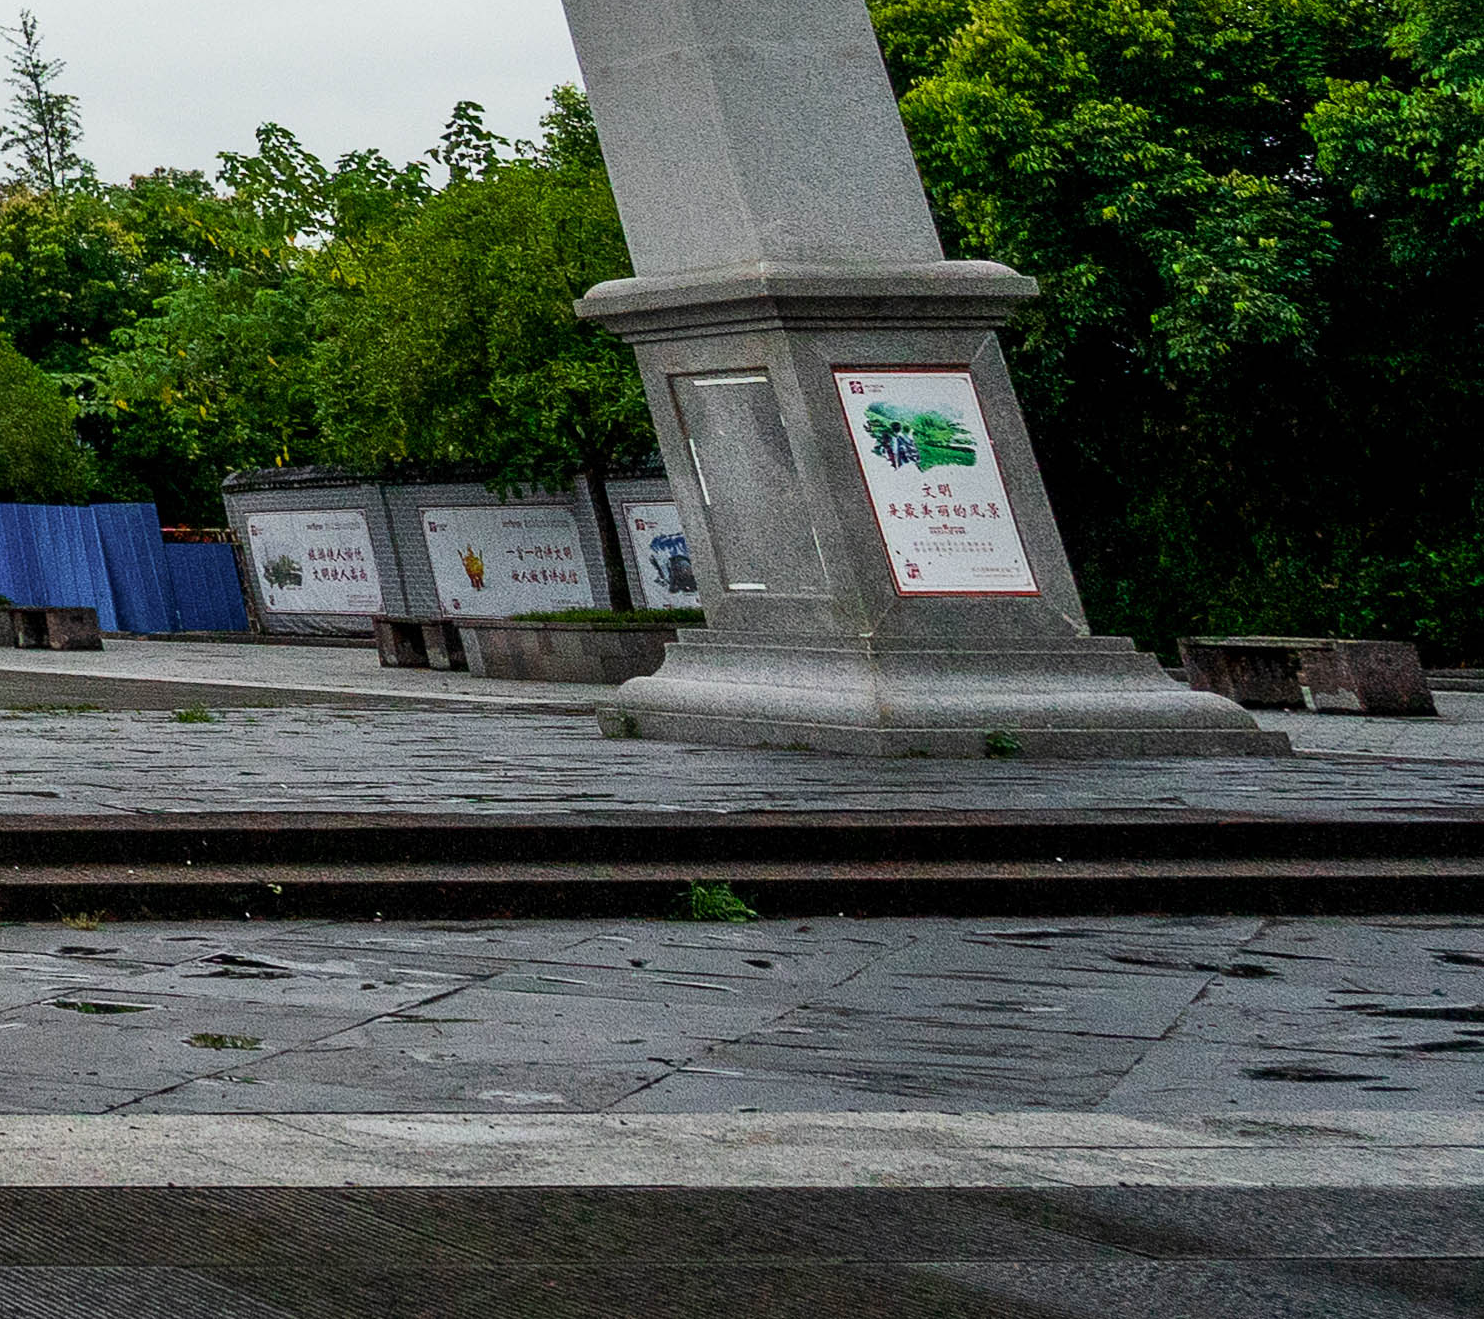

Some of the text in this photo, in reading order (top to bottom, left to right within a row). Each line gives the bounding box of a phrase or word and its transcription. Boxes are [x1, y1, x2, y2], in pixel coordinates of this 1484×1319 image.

[921, 482, 953, 499] 文明
[887, 501, 1002, 520] 是最美丽的风景
